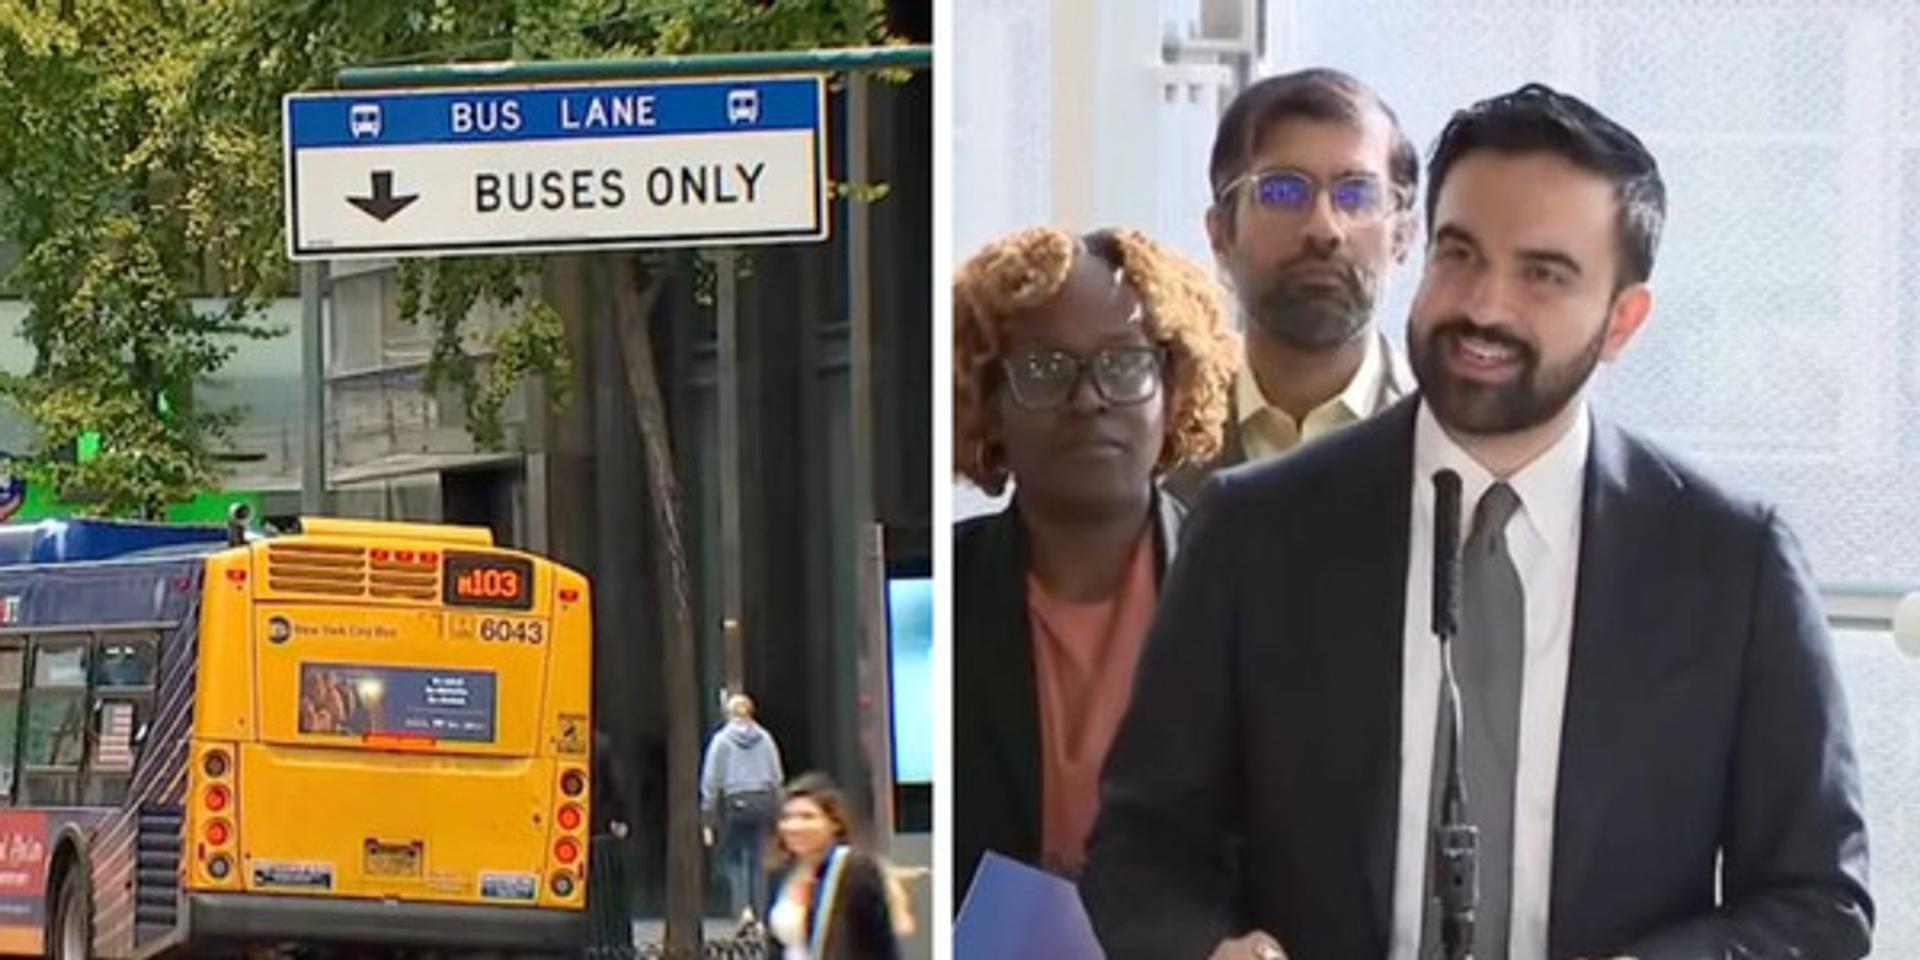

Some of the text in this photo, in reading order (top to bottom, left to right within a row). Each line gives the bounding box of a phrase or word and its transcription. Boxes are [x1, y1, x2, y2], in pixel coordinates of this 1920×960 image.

[452, 95, 656, 134] BUS LANE
[475, 162, 766, 213] BUSES ONLY
[480, 617, 543, 645] 6043
